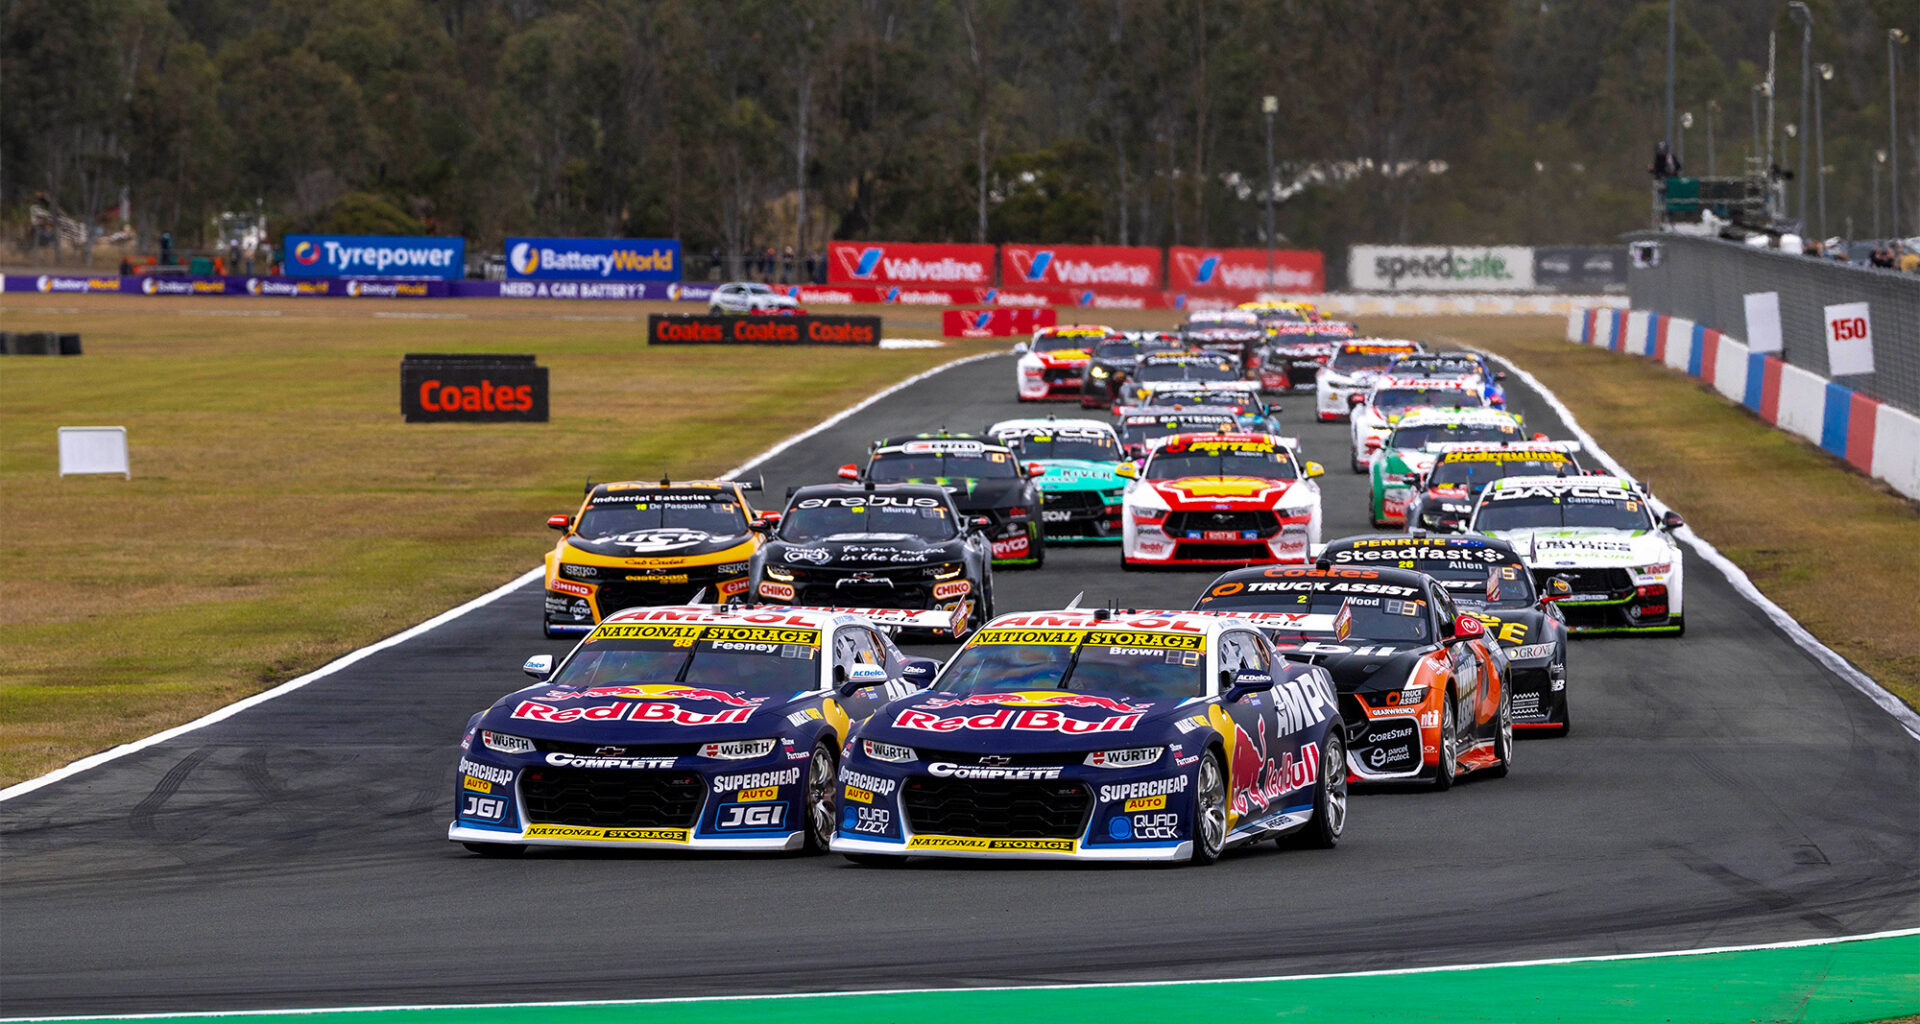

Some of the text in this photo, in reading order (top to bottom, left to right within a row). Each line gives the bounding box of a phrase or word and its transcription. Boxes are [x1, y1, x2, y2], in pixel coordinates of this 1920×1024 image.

[324, 241, 454, 269] Tyrepower
[541, 249, 673, 276] BatteryWorld
[884, 257, 983, 280] Valvoline
[1054, 260, 1150, 285] Valvoline
[500, 283, 646, 298] NEED A CAR BATTERY?
[657, 320, 873, 342] Coates Coates Coates
[1831, 317, 1867, 341] 150
[420, 379, 533, 412] Coates
[592, 493, 712, 504] Industrial Batteries
[1493, 486, 1630, 501] DAYCO
[1567, 496, 1615, 505] Cameron
[649, 502, 662, 510] De
[664, 502, 708, 511] Pasquale
[798, 495, 940, 509] erebus
[882, 506, 918, 516] Murray
[992, 536, 1029, 554] RYCO
[1353, 538, 1447, 549] PENRITE
[1335, 546, 1473, 563] Steadfast
[566, 564, 598, 576] SEIKO
[1398, 560, 1414, 569] 26
[1449, 561, 1483, 570] Allen
[1264, 568, 1380, 579] Coates
[560, 583, 589, 595] HINO
[760, 584, 793, 598] CHIKO
[935, 582, 970, 596] CHIKO
[1247, 582, 1419, 597] TRUCK ASSIST
[1296, 595, 1308, 604] 2
[1345, 596, 1380, 607] Wood
[596, 626, 814, 644] NATIONAL STORAGE
[977, 631, 1195, 648] NATIONAL STORAGE
[673, 637, 694, 648] 88
[712, 640, 778, 654] Feeney
[1069, 645, 1078, 654] 1
[1110, 646, 1164, 657] Brown
[1182, 650, 1200, 667] 2
[1237, 674, 1273, 682] ACDelco
[510, 700, 632, 724] Red
[626, 702, 762, 726] Bull
[1372, 707, 1416, 716] GEARWRENCH
[891, 708, 1016, 732] Red
[1010, 709, 1146, 735] Bull
[492, 733, 529, 750] WÜRTH
[721, 742, 770, 756] WÜRTH
[873, 743, 911, 759] WÜRTH
[1107, 748, 1157, 763] WÜRTH
[545, 752, 676, 769] COMPLETE
[928, 762, 1061, 780] COMPLETE
[1264, 741, 1320, 800] Red Bull
[466, 779, 489, 790] AUTO
[713, 767, 801, 794] SUPERCHEAP
[741, 789, 774, 799] AUTO
[847, 788, 871, 800] AUTO
[1100, 774, 1189, 804] SUPERCHEAP
[463, 796, 504, 819] JGI
[1129, 798, 1162, 809] AUTO
[721, 805, 783, 827] JGI
[858, 806, 890, 823] QUAD
[1133, 813, 1178, 827] QUAD
[527, 827, 684, 840] NATIONAL STORAGE
[855, 819, 889, 834] LOCK
[1133, 825, 1179, 839] LOCK
[911, 837, 1071, 850] NATIONAL STORAGE
